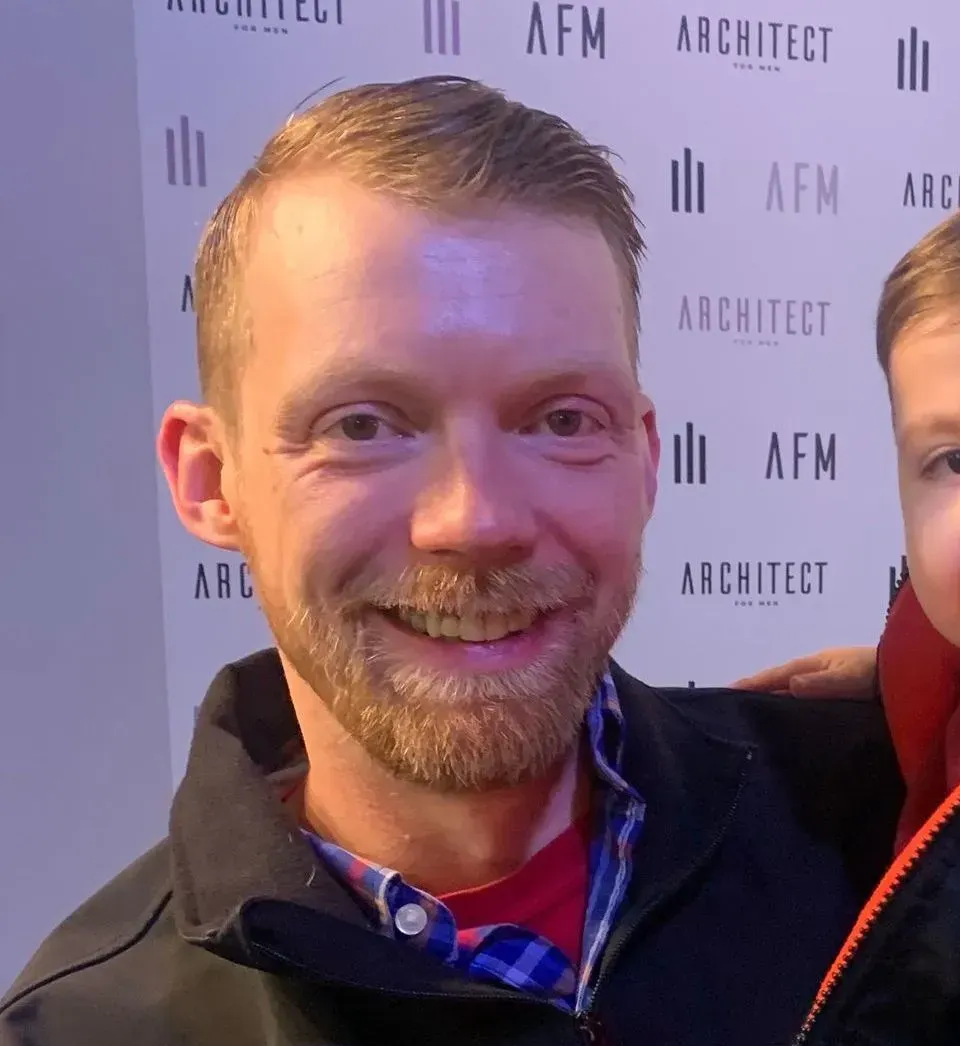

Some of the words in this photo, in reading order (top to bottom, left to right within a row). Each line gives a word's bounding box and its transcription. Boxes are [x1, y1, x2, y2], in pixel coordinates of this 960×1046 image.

[526, 1, 606, 59] AFM
[677, 15, 833, 63] ARCHITECT
[766, 161, 839, 215] AFM
[678, 295, 831, 336] ARCHITECT
[765, 432, 837, 481] AFM
[681, 561, 828, 595] ARCHITECT
